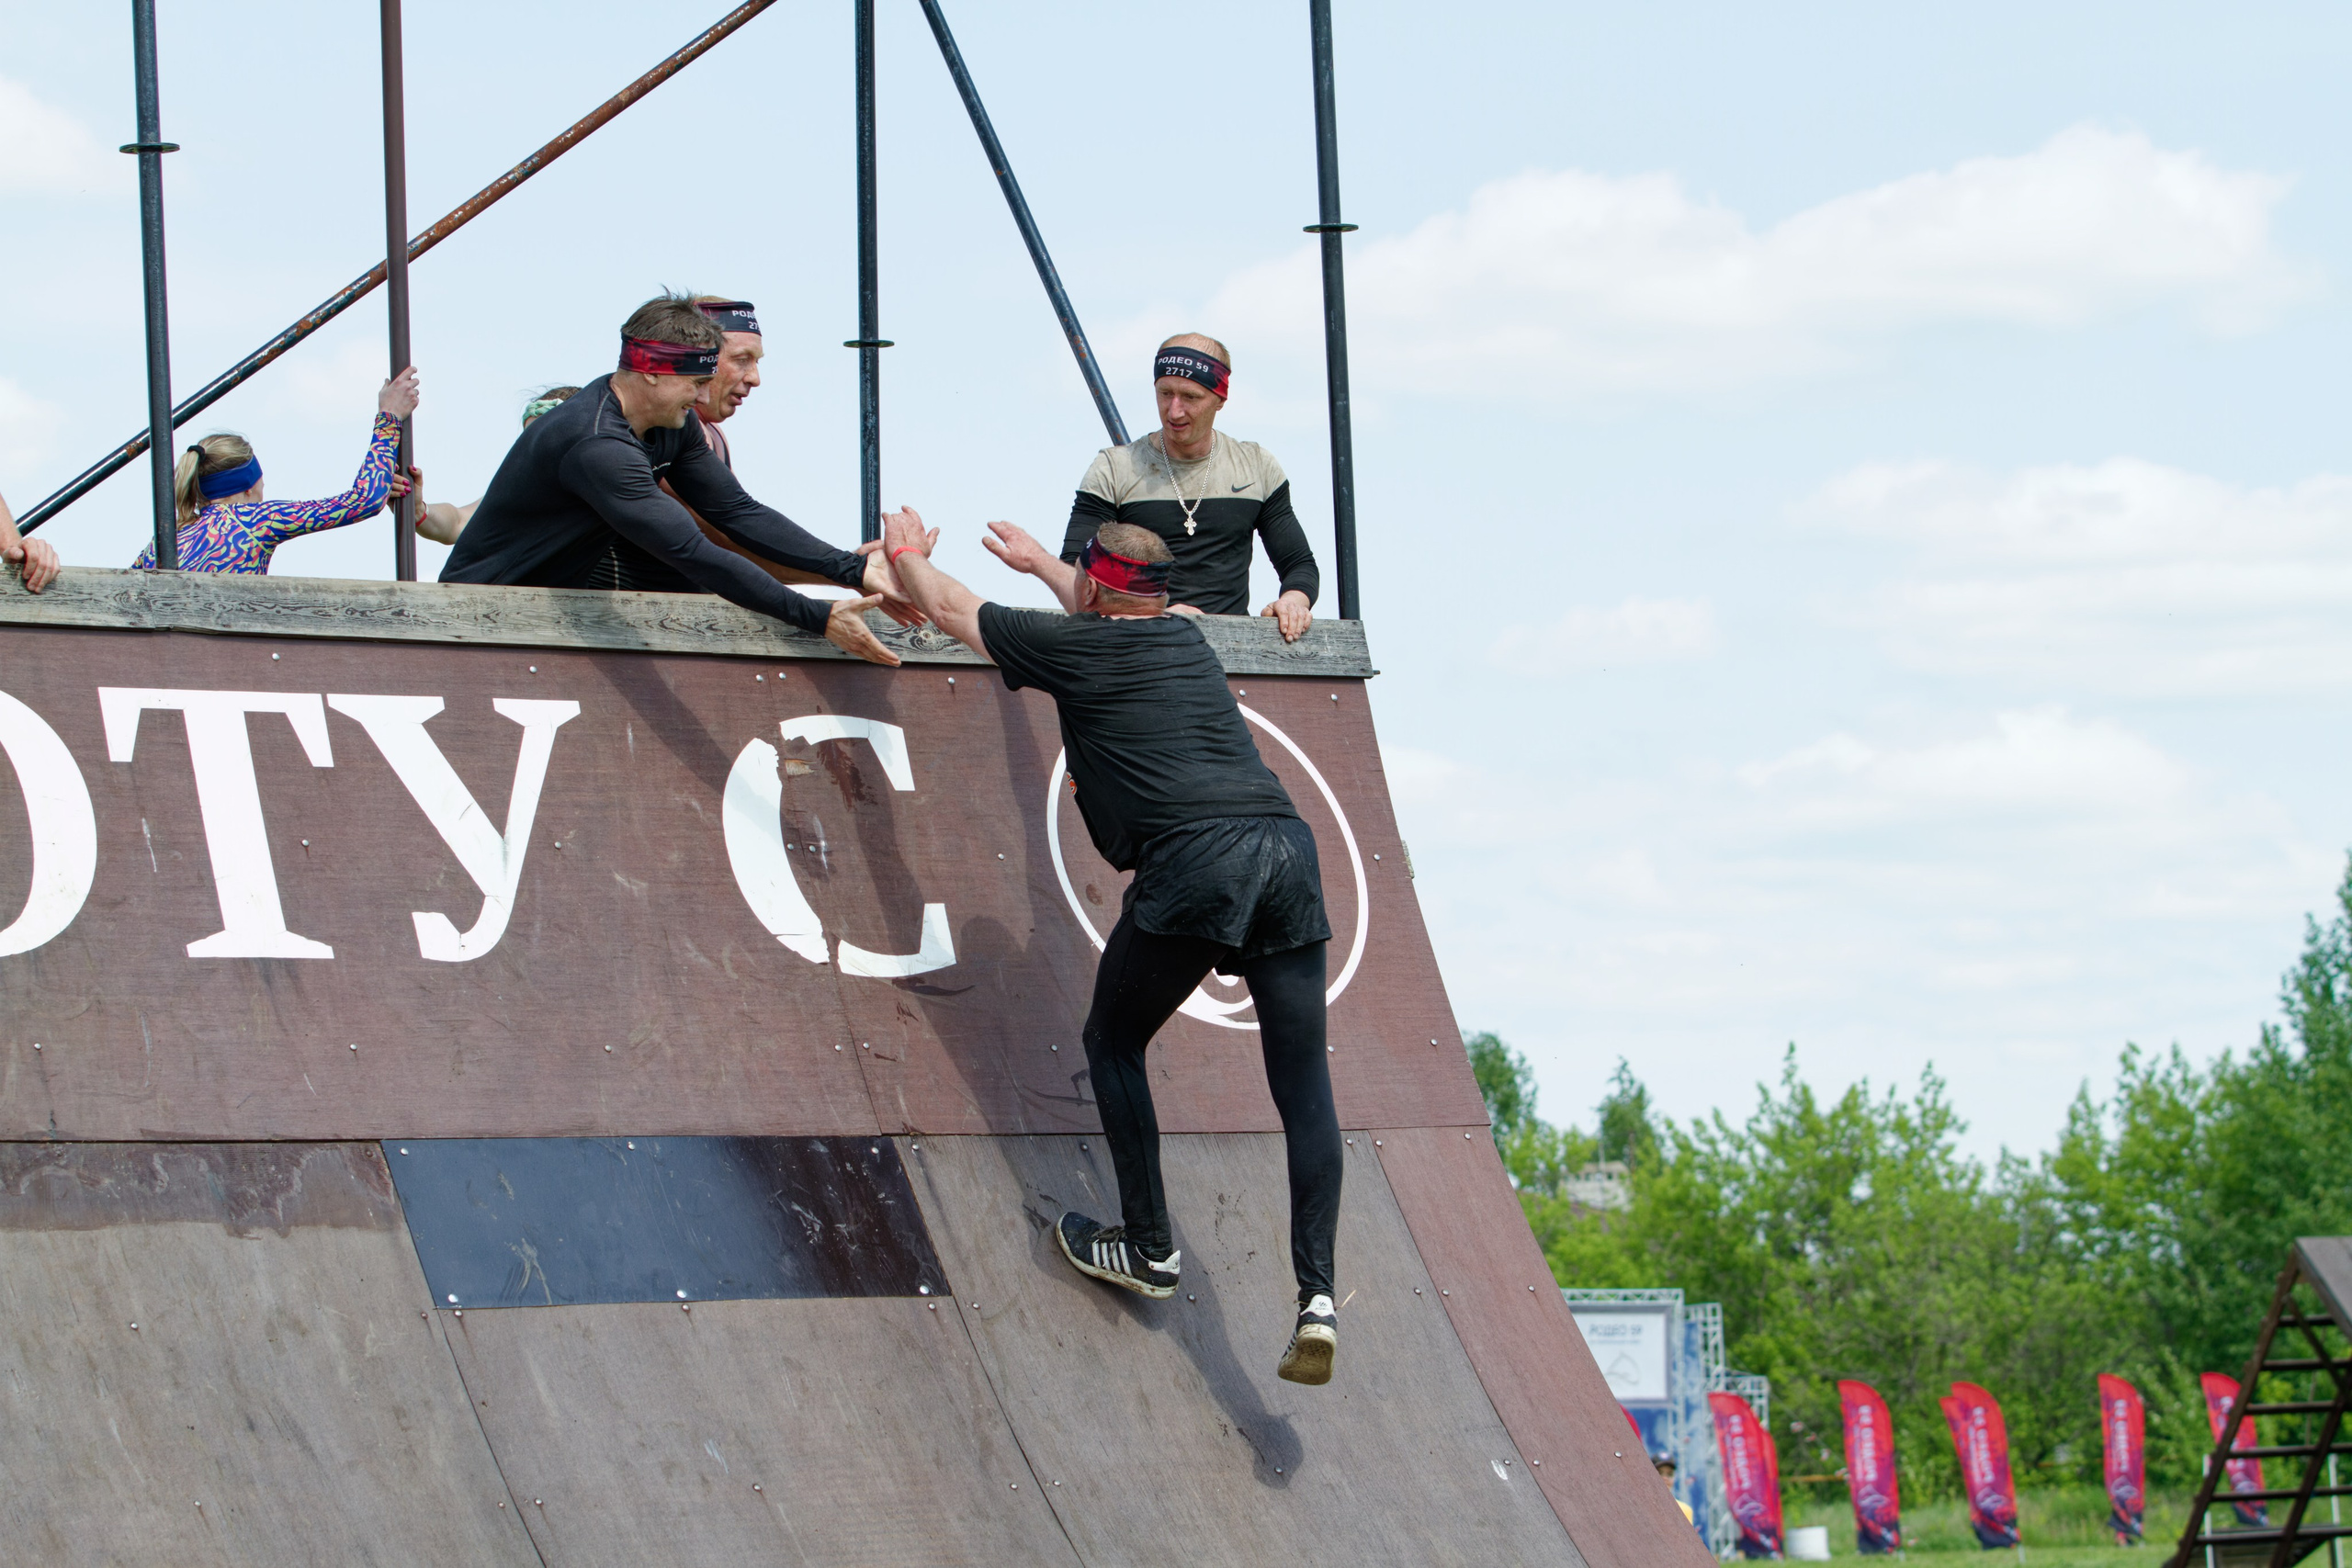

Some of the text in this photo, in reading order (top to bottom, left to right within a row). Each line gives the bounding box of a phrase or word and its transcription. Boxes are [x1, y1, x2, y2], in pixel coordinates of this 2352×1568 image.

[1158, 356, 1209, 373] РОДЕО 59
[1165, 367, 1193, 378] 2717
